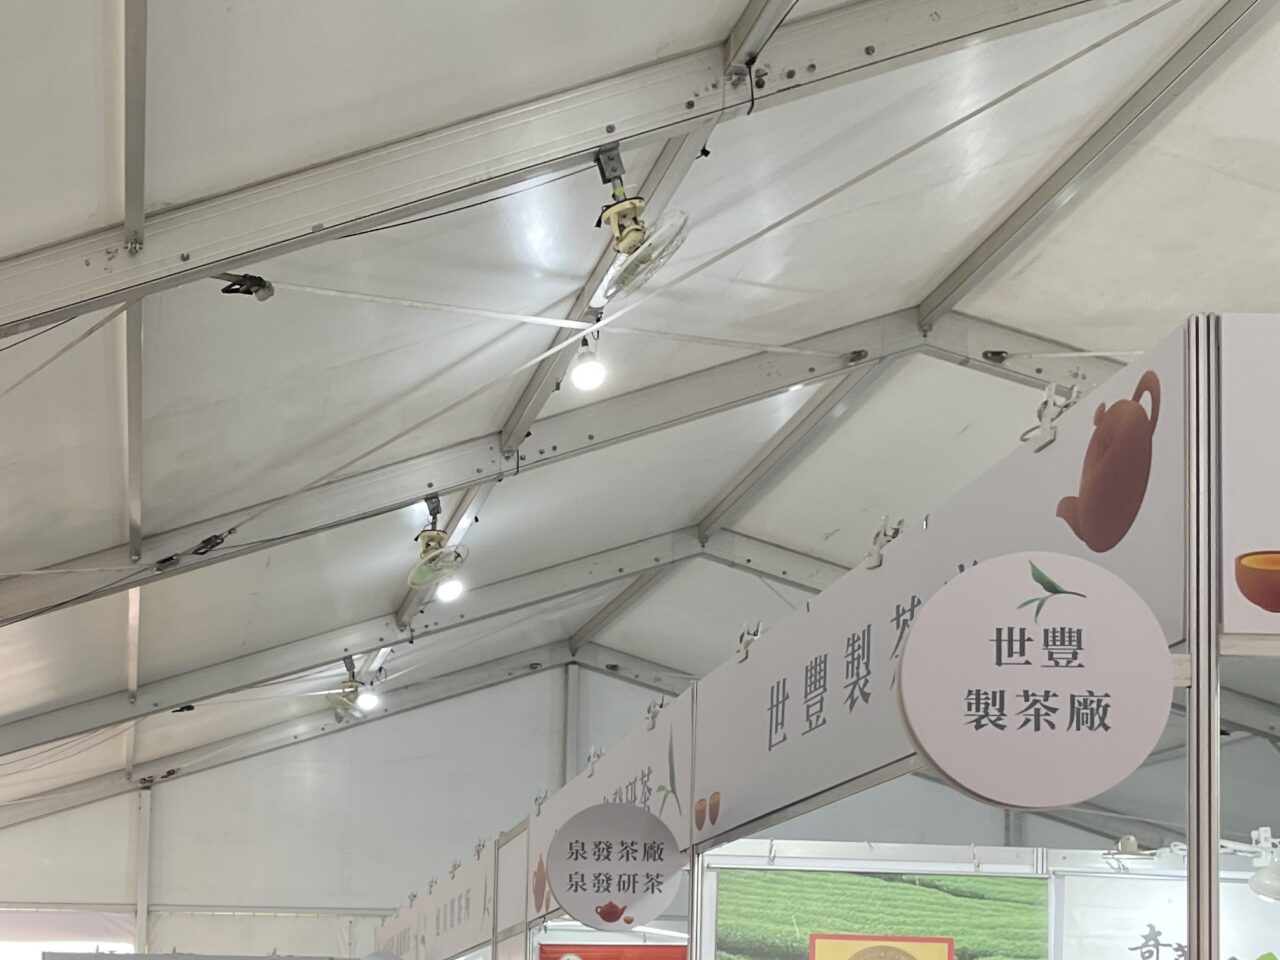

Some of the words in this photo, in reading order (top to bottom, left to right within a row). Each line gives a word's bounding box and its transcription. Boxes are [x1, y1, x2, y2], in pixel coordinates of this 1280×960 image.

[989, 626, 1085, 669] 世豐
[963, 688, 1112, 734] 製茶廠
[566, 840, 664, 862] 泉發茶廠
[566, 872, 664, 894] 泉發研茶
